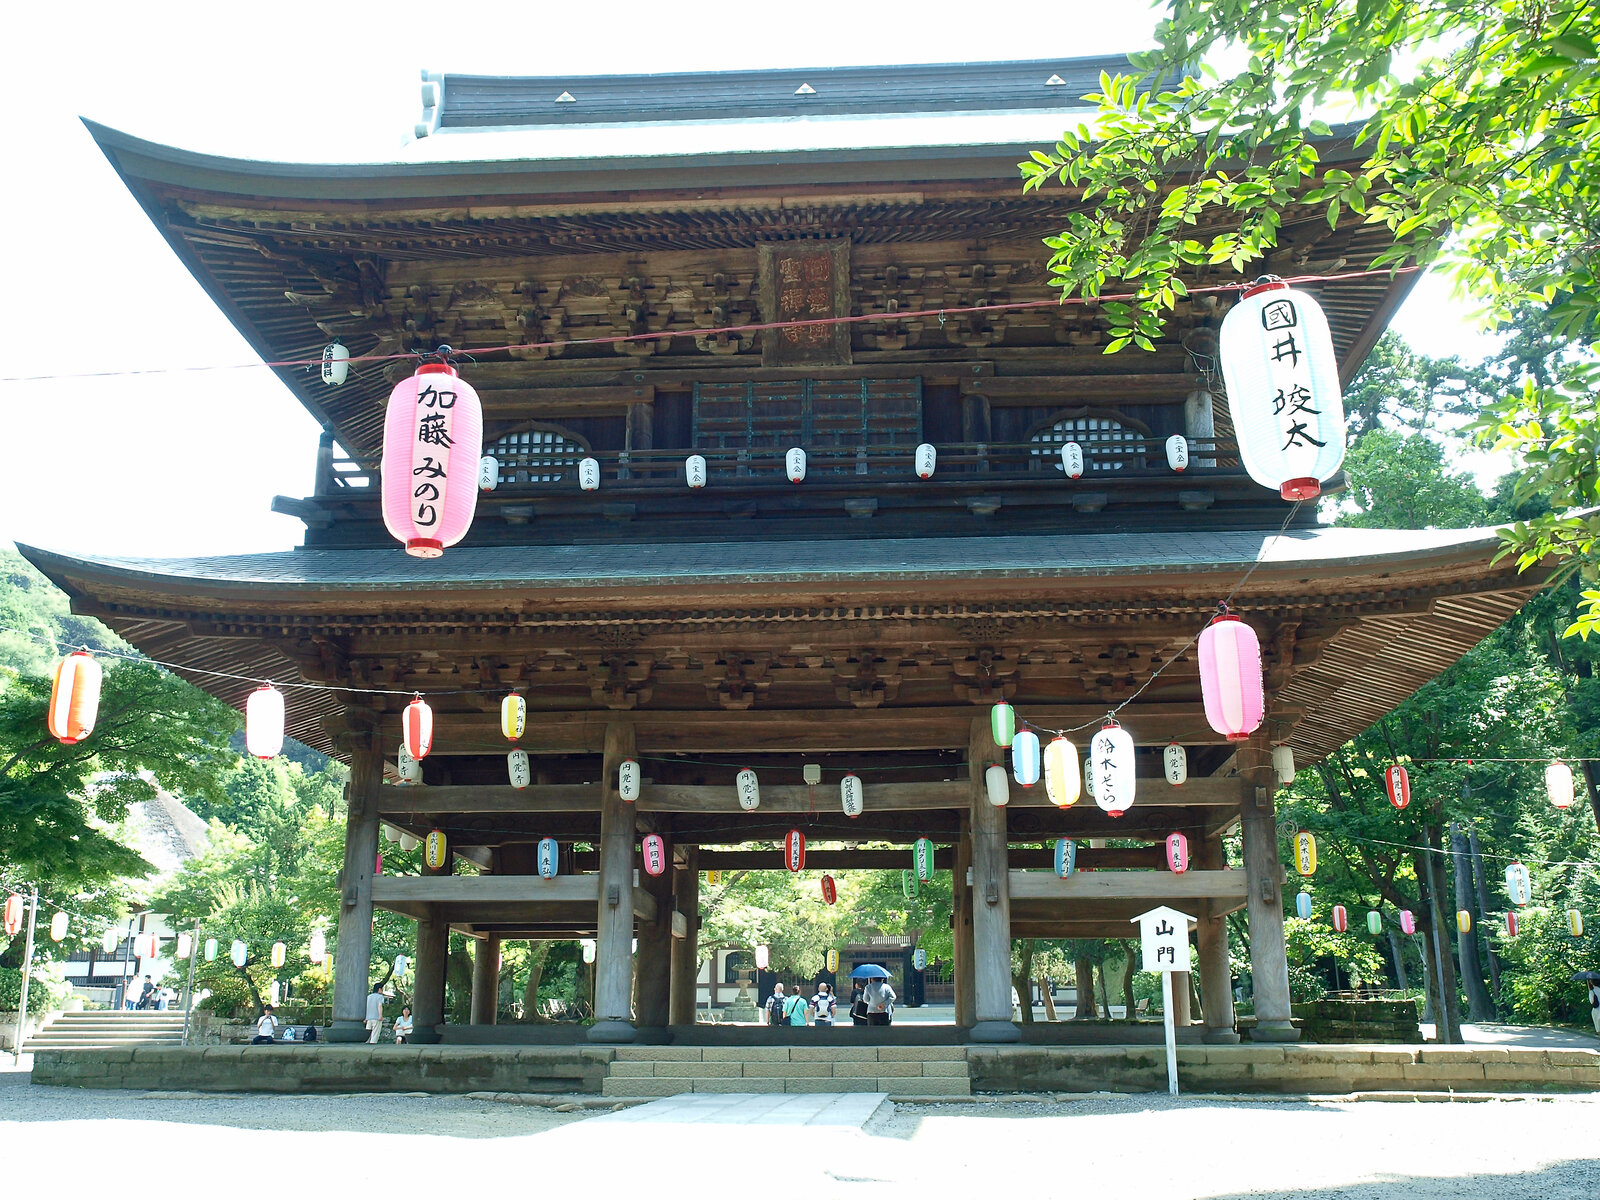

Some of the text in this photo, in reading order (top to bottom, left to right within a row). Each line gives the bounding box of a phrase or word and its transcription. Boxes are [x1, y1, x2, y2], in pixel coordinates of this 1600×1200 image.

[412, 384, 459, 527] 加藤みのり
[692, 457, 702, 482] 三宝会
[792, 449, 802, 473] 三宝会
[584, 460, 594, 485] 三宝会
[512, 752, 524, 784] 円覚寺
[622, 763, 632, 795] 円覚寺
[1097, 737, 1117, 804] 鈴木そら
[1168, 747, 1181, 781] 円覚寺
[741, 773, 754, 806] 円覚寺
[1155, 919, 1175, 964] 山門
